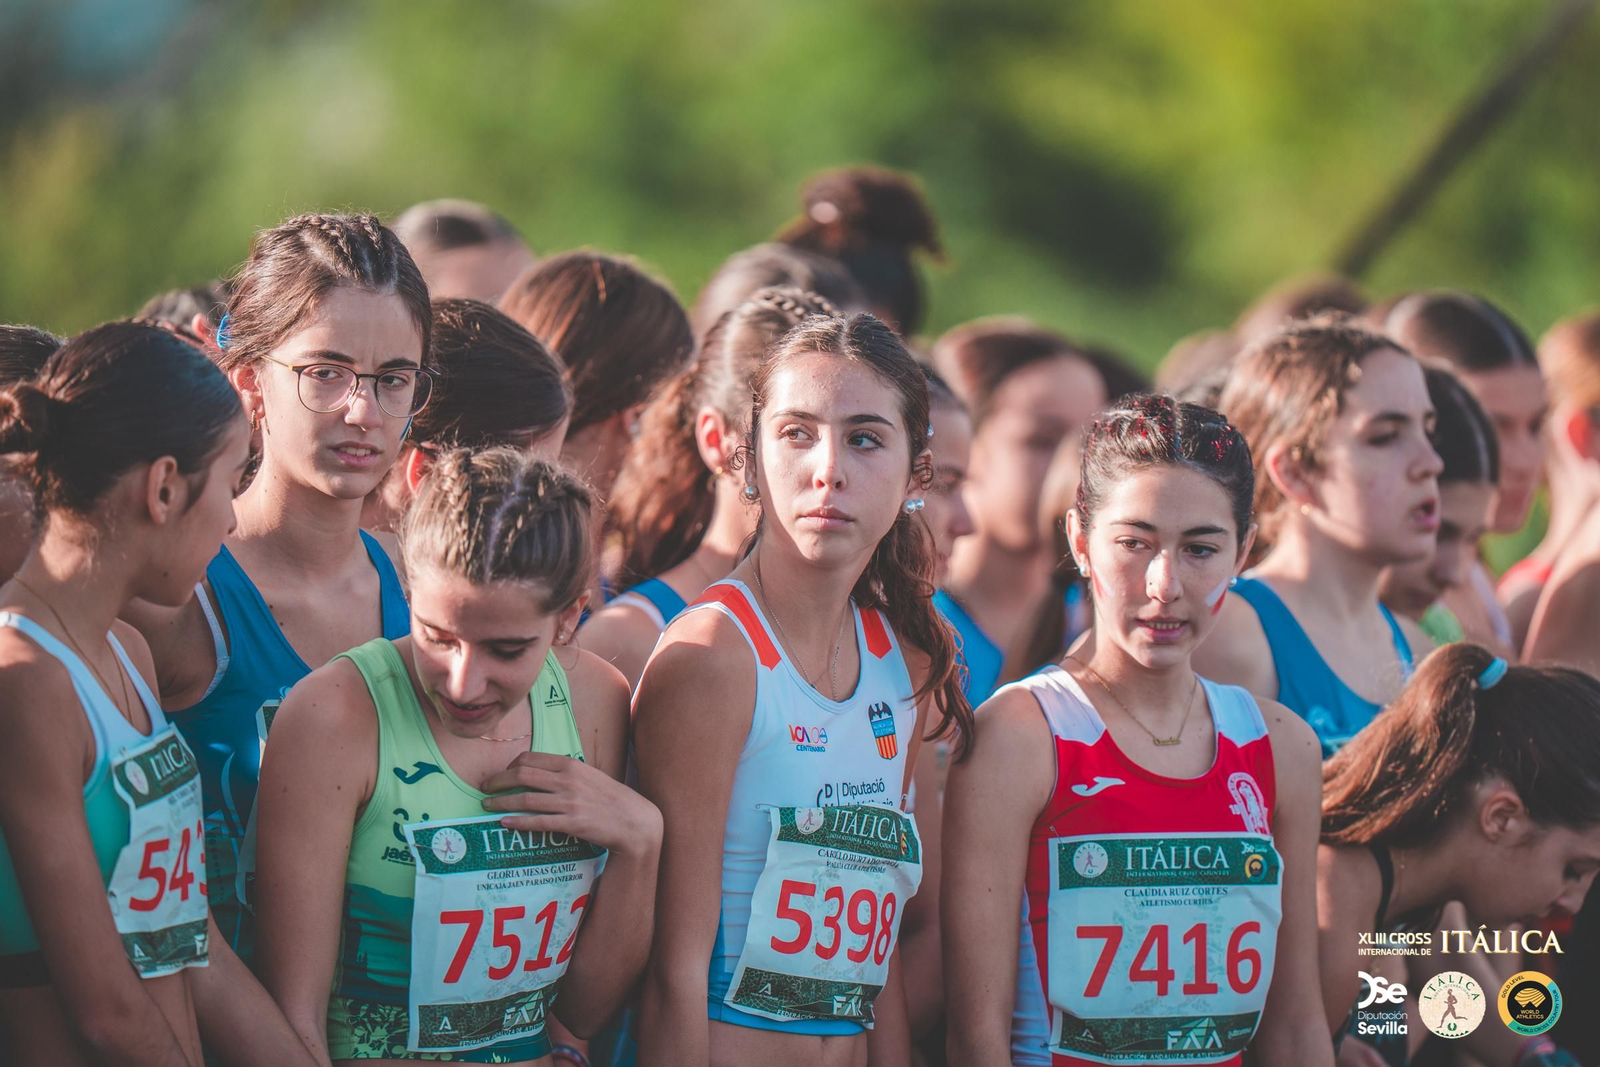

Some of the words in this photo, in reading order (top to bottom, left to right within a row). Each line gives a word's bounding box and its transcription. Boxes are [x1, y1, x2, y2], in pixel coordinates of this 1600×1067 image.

[796, 744, 826, 752] CENTENARIO
[842, 777, 885, 800] Diputació
[832, 806, 899, 844] ITÁLICA
[1125, 839, 1230, 870] ITÁLICA
[487, 869, 520, 880] GLORIA
[522, 866, 549, 877] MESAS
[550, 863, 577, 874] GAMIZ
[1126, 870, 1177, 878] INTERNATIONAL
[477, 882, 506, 891] UNICAJA
[507, 880, 525, 889] JAEN
[526, 877, 554, 886] PARAISO
[554, 873, 583, 883] INTERIOR
[1124, 887, 1168, 898] CLAUDIA
[1169, 887, 1190, 897] RUIZ
[1191, 886, 1228, 896] CORTES
[1139, 898, 1183, 907] ATLETISMO
[771, 879, 896, 966] 5398
[1076, 921, 1262, 998] 7416
[1167, 1029, 1223, 1050] FAA
